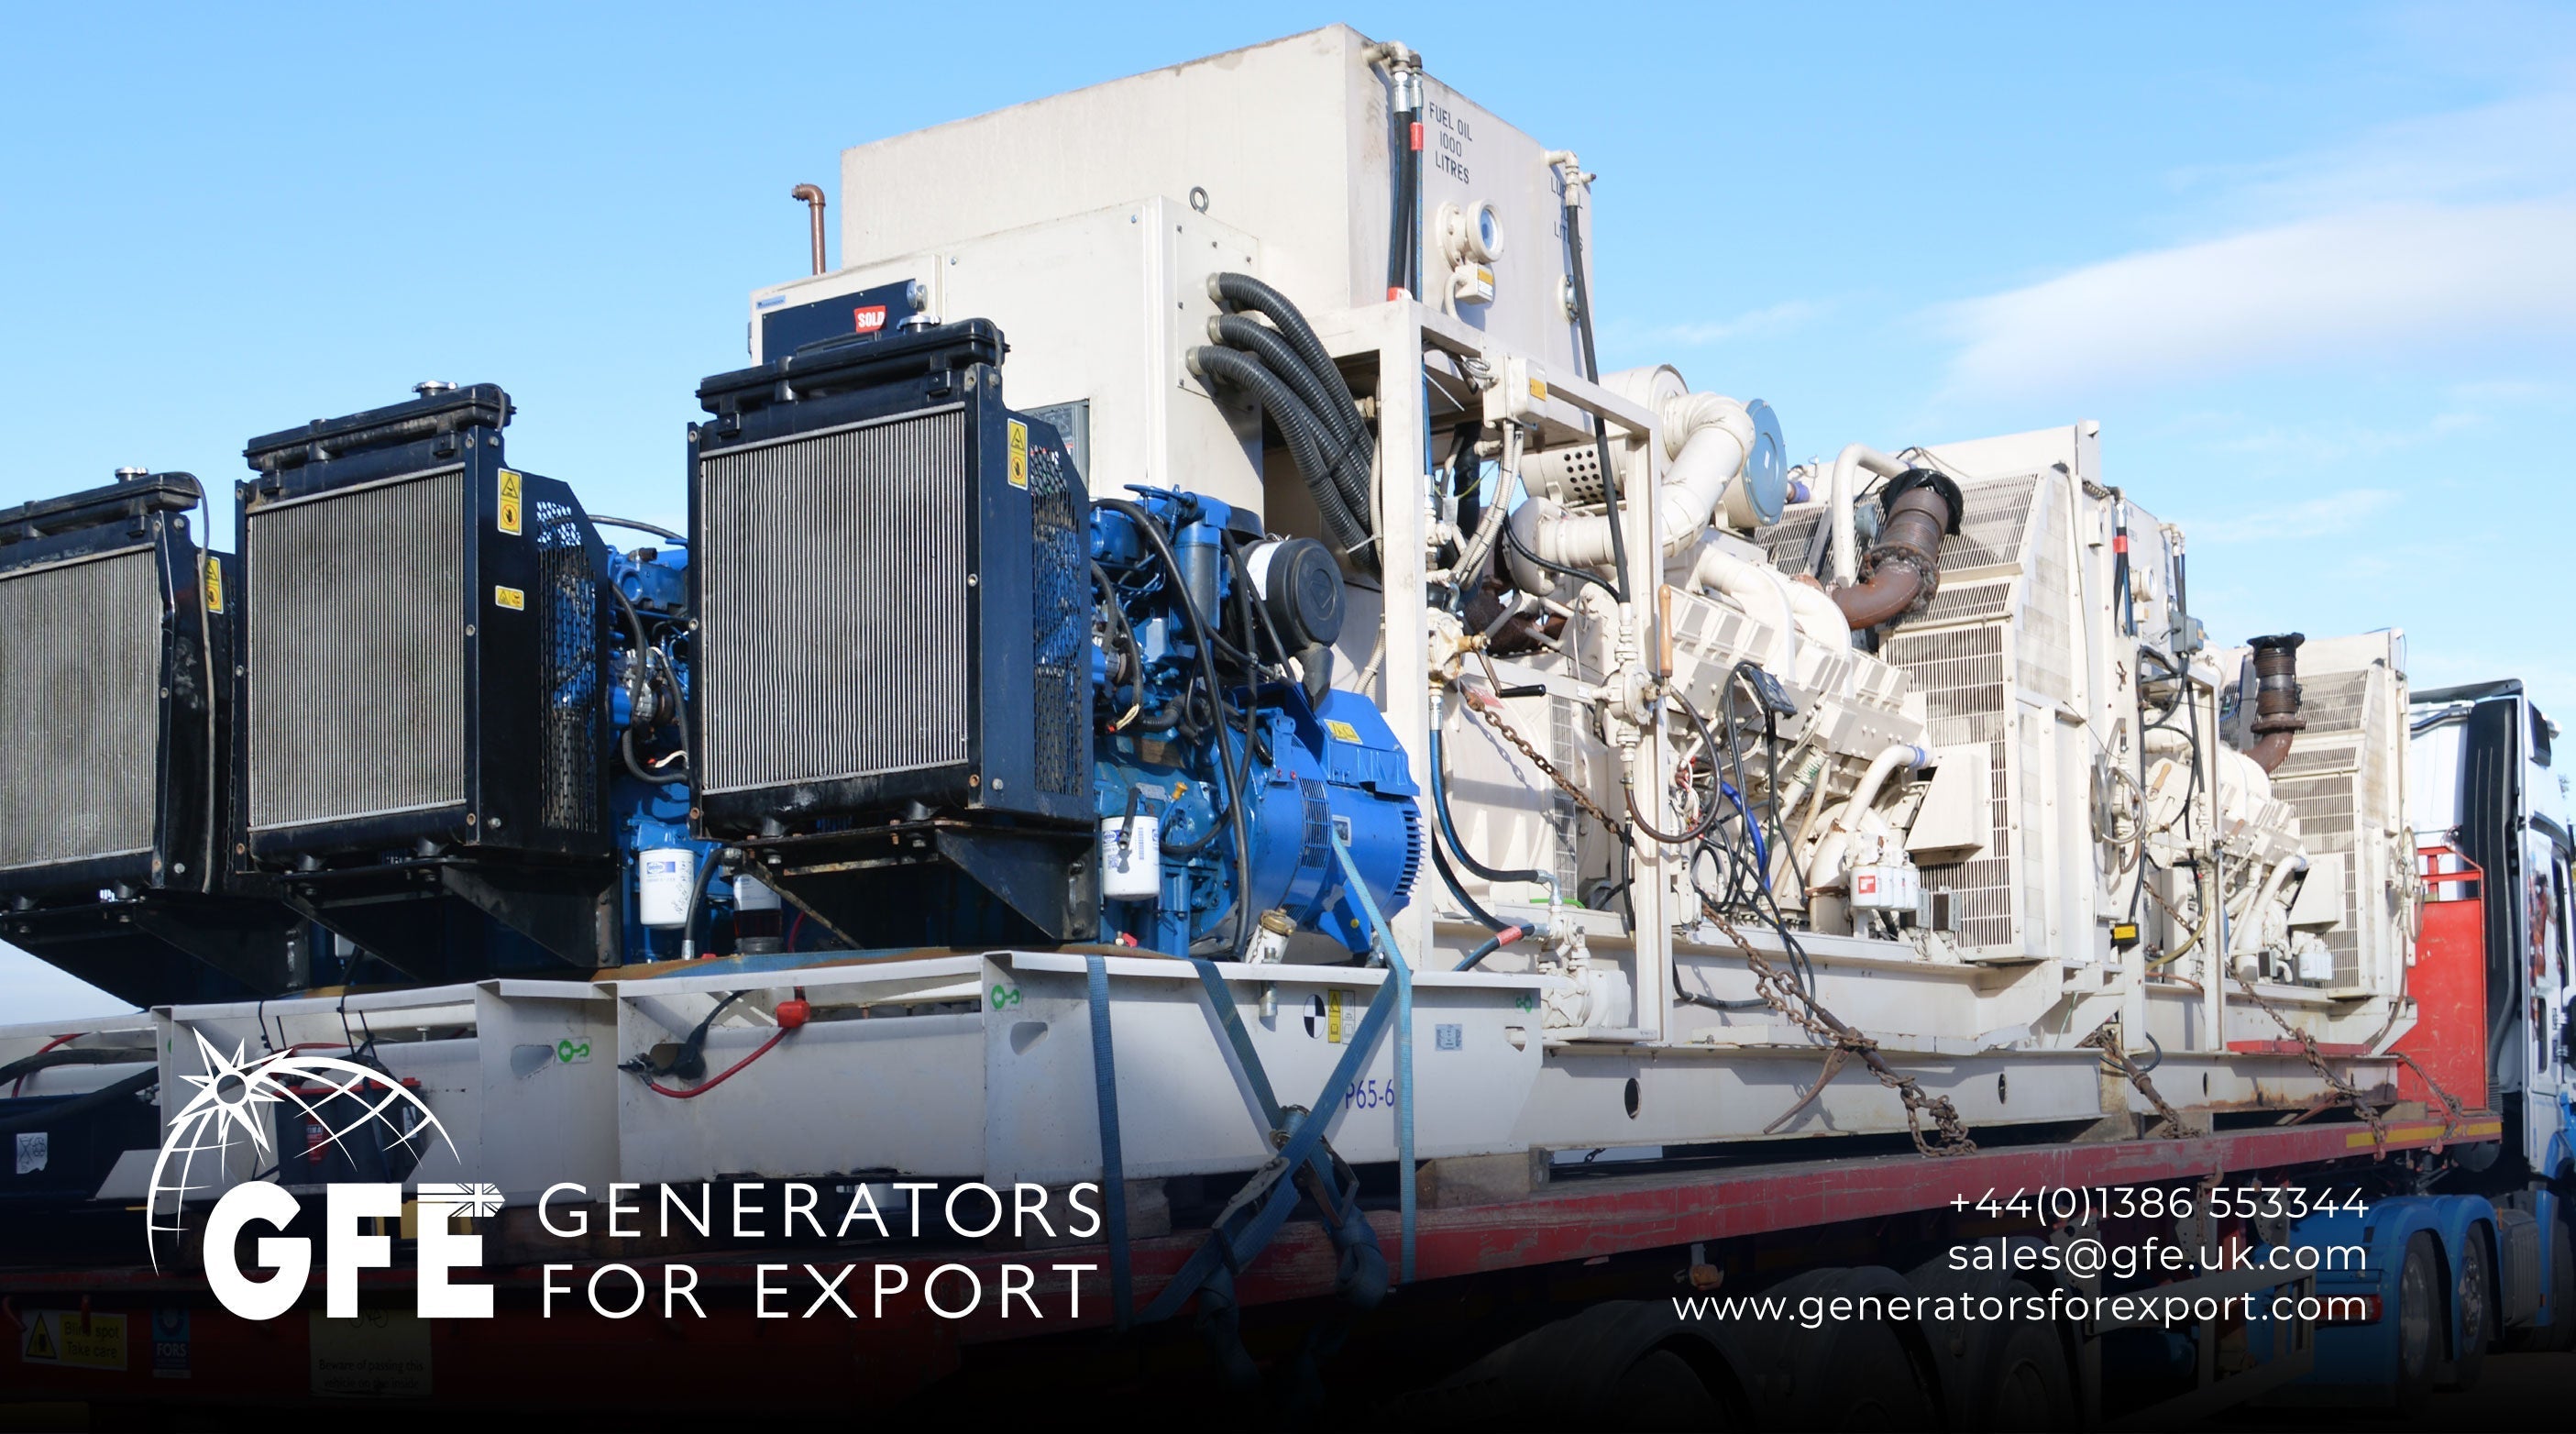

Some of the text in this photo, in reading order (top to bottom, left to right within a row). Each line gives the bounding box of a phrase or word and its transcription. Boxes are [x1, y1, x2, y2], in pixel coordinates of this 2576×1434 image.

[1429, 101, 1473, 142] FUEL OIL
[1439, 130, 1462, 158] 1000
[1435, 149, 1470, 184] LITRES
[856, 311, 886, 329] SOLD
[1345, 1078, 1395, 1109] P65-6
[64, 1321, 119, 1341] Blin spot
[67, 1341, 117, 1358] Take care
[157, 1342, 187, 1357] FORS
[318, 1359, 424, 1375] Beware of passing this
